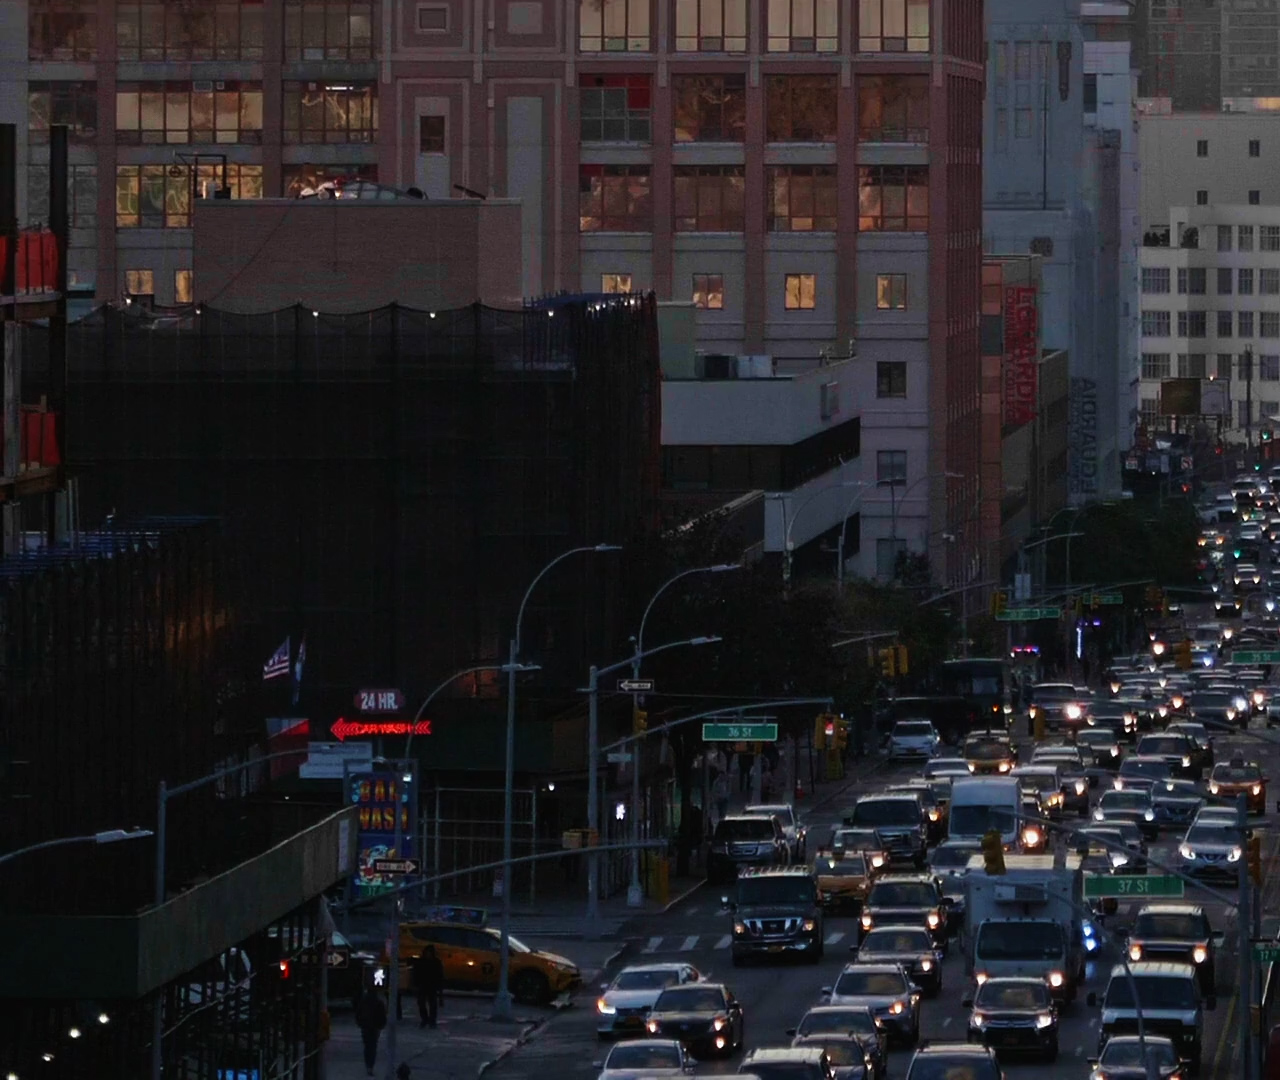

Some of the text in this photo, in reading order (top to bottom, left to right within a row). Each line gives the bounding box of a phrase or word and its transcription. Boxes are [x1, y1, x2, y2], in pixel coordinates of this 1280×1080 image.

[360, 692, 376, 709] 24
[728, 728, 752, 738] 36 St
[1118, 880, 1149, 893] 37 St
